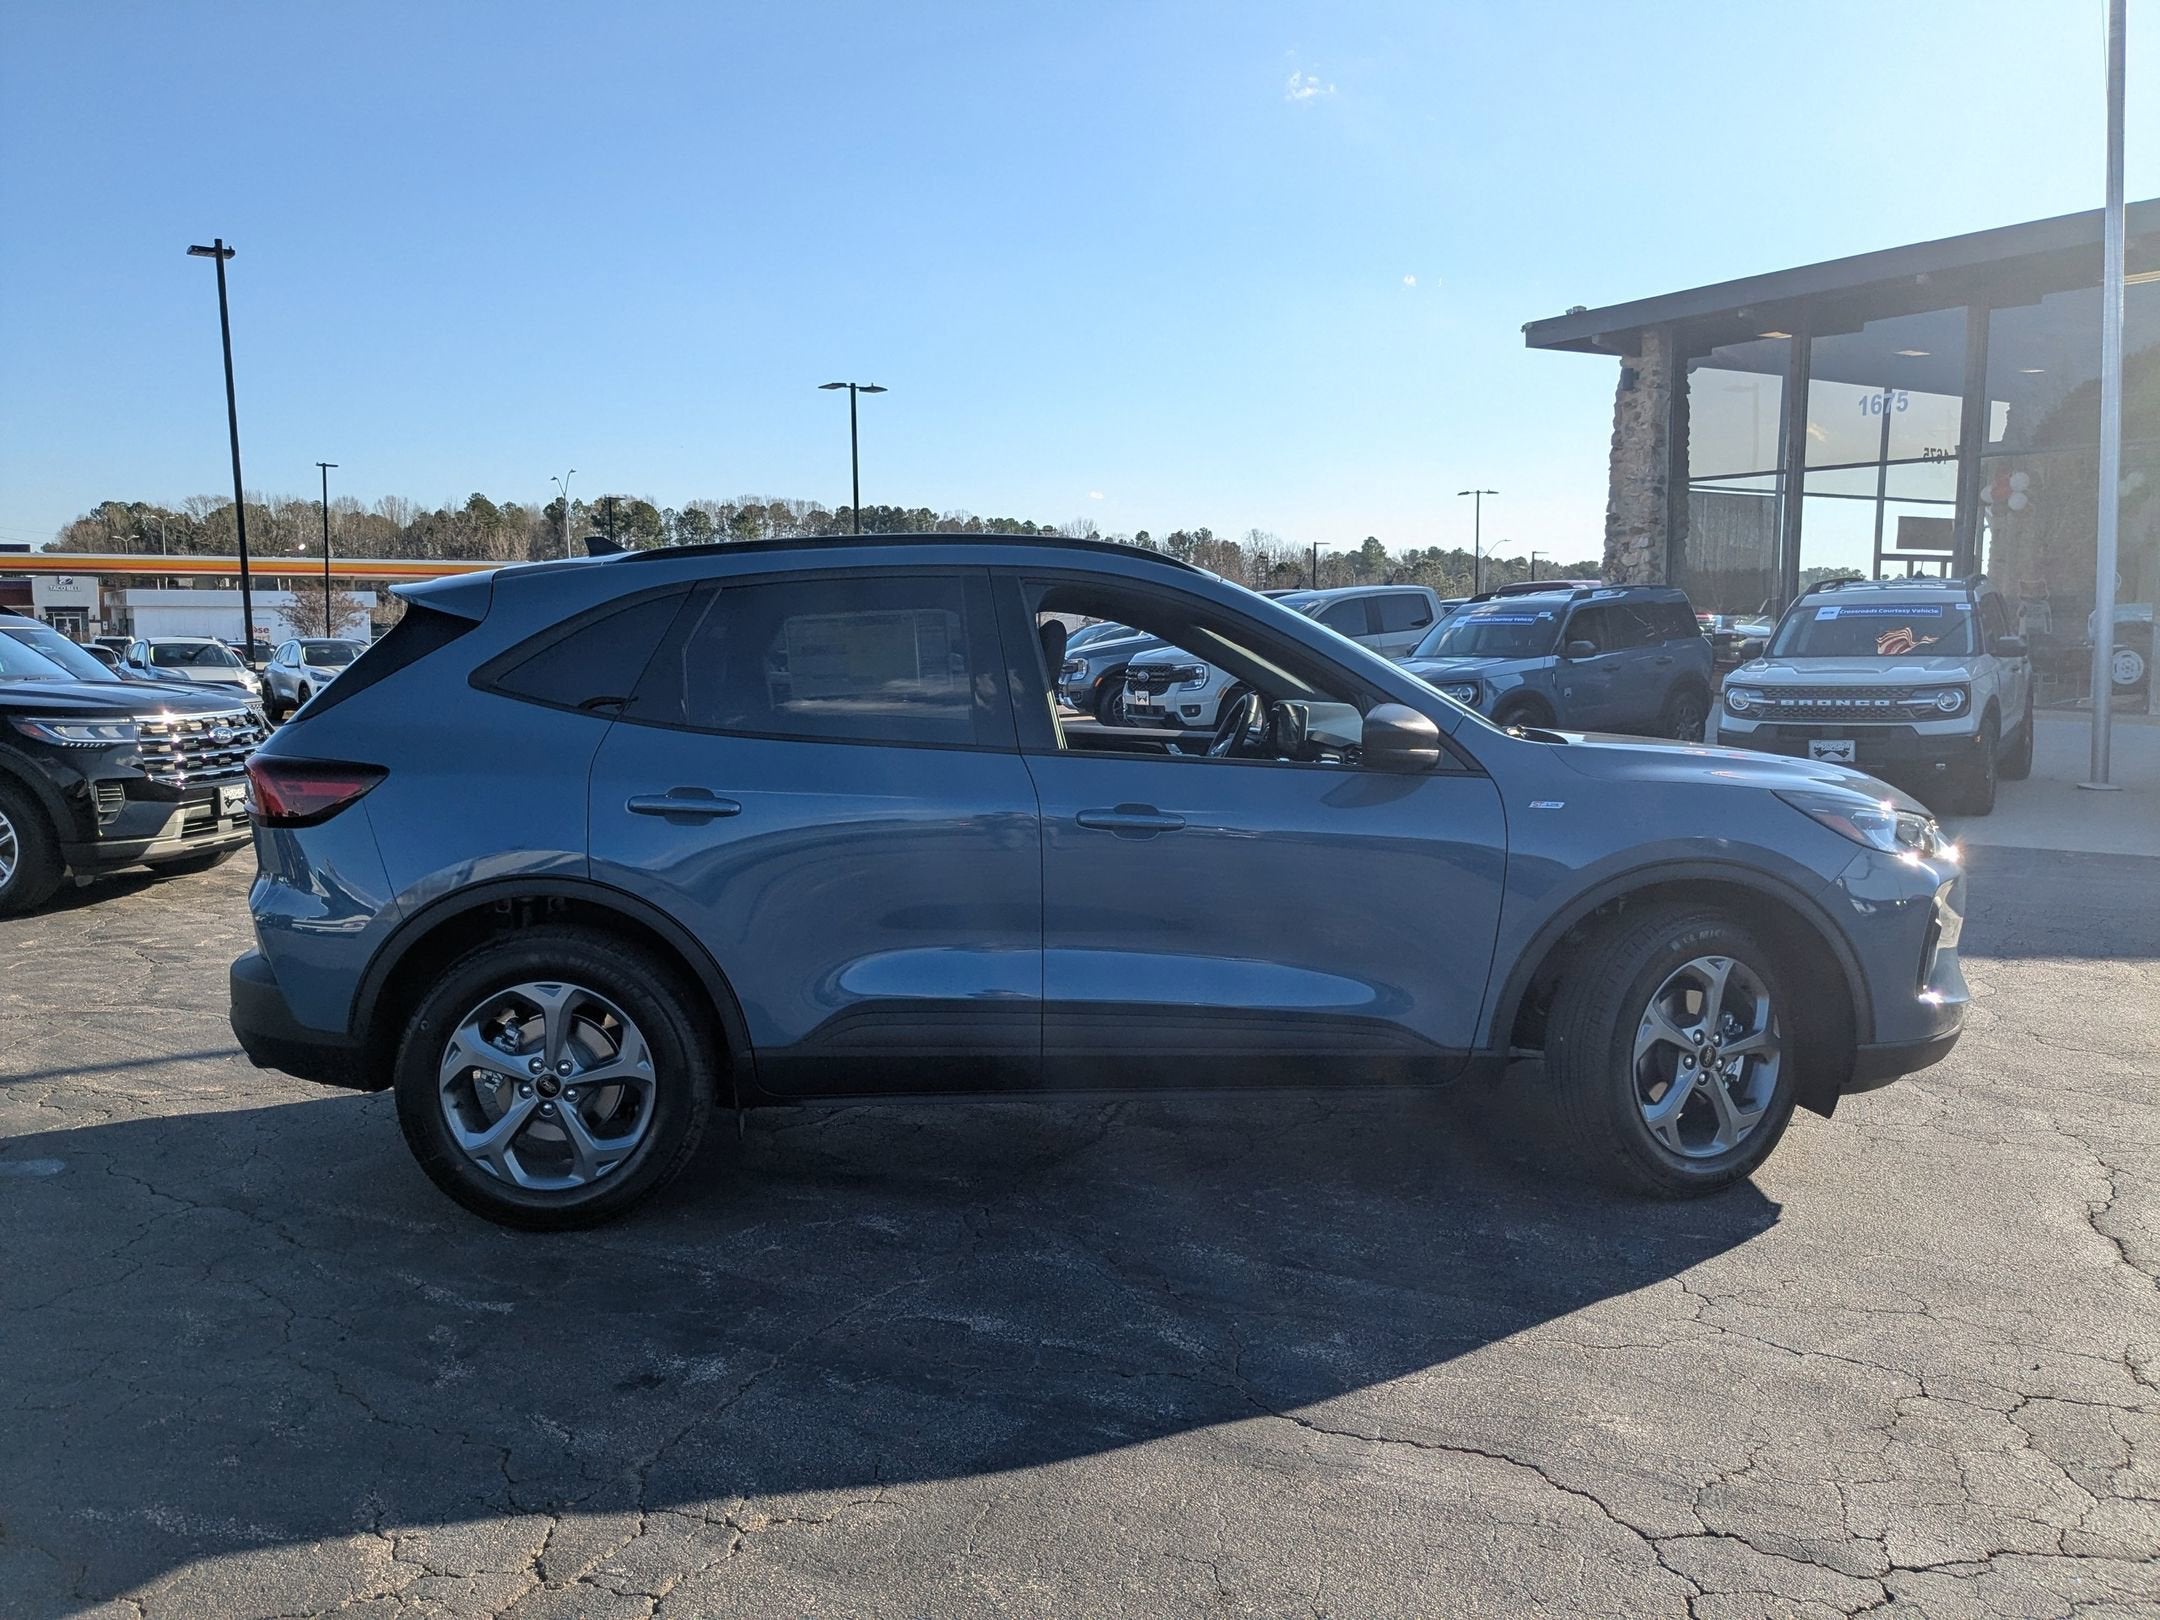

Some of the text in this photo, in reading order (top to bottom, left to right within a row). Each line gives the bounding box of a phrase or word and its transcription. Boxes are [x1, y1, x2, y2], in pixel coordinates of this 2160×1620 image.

[1858, 391, 1909, 416] 1675
[1878, 607, 1910, 615] Courtesy
[1911, 607, 1940, 615] Vehicle
